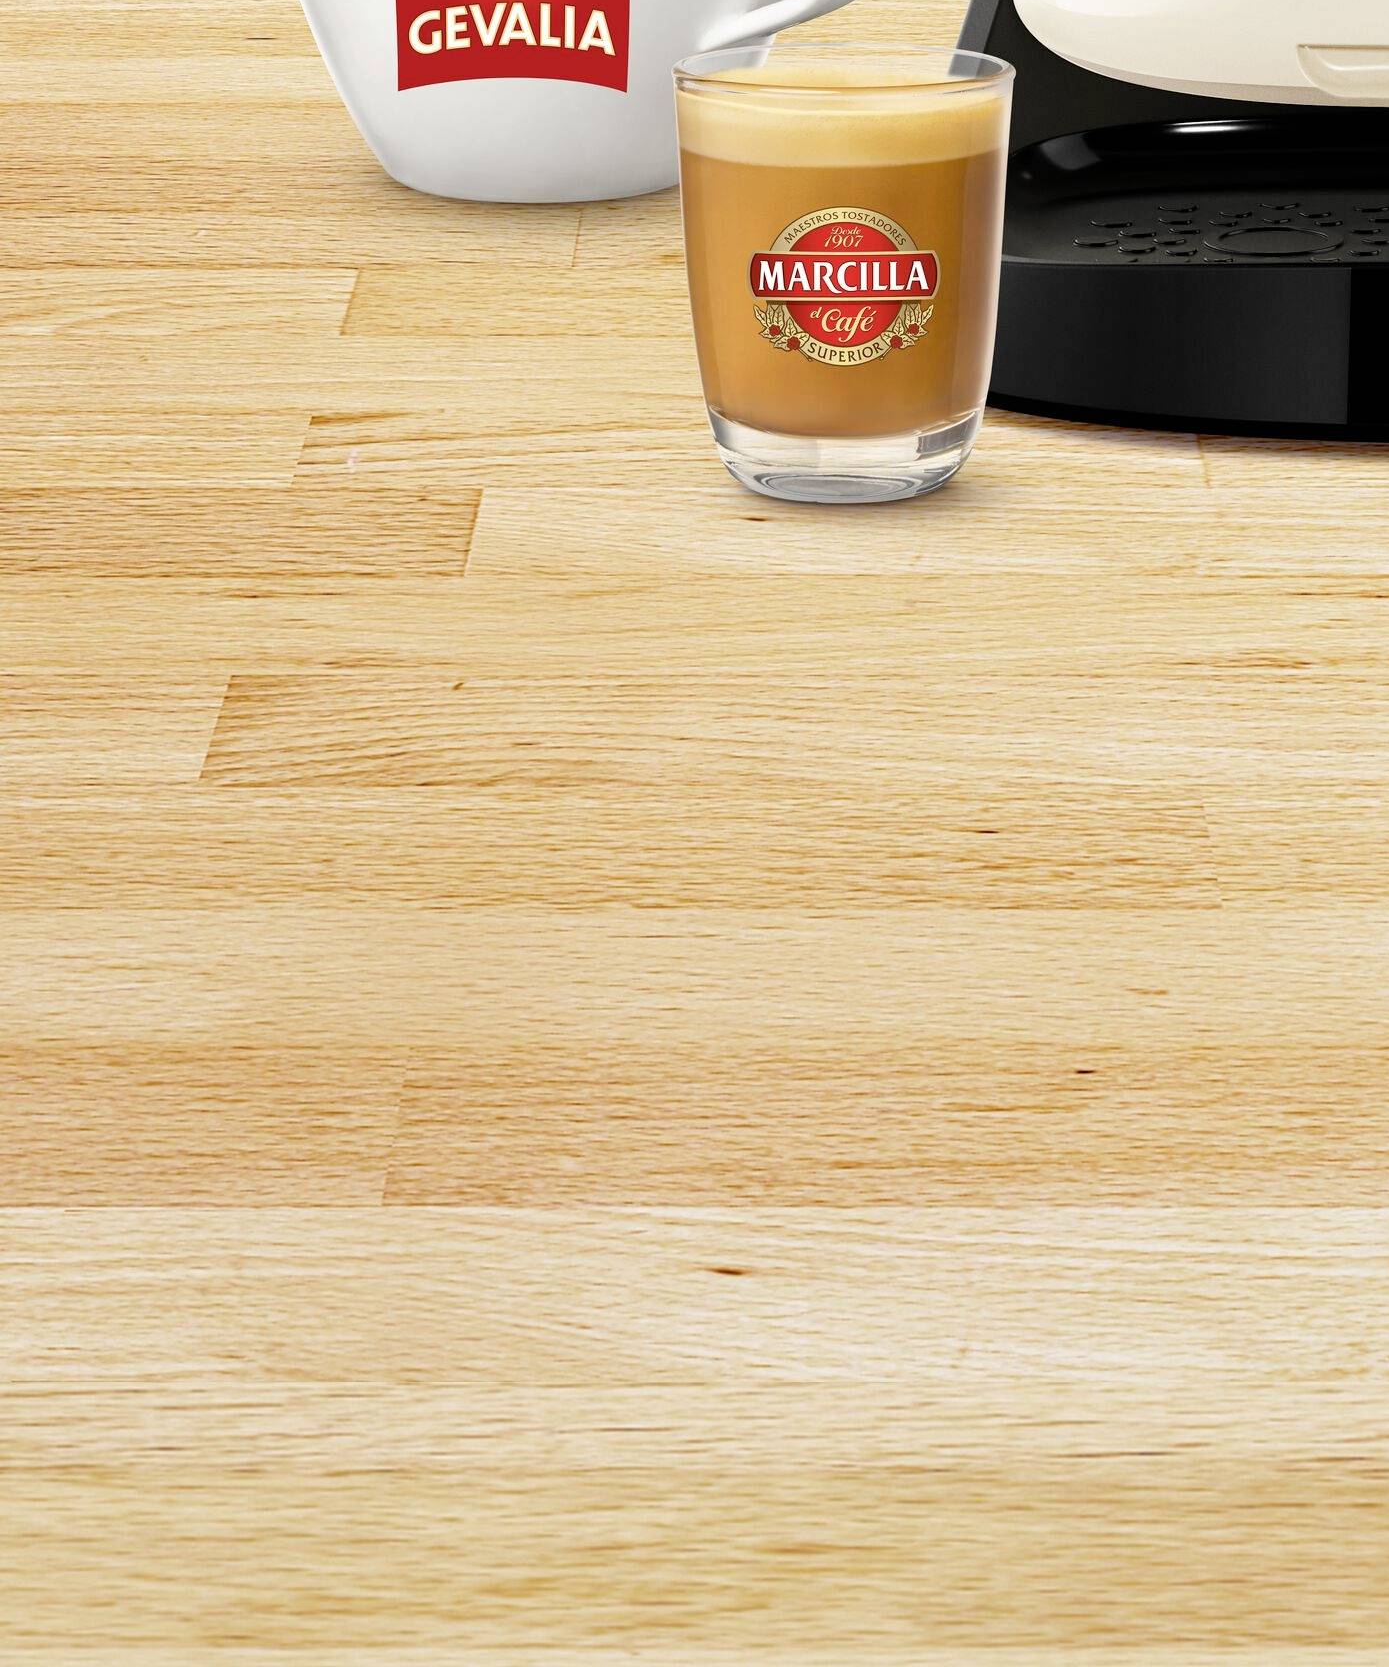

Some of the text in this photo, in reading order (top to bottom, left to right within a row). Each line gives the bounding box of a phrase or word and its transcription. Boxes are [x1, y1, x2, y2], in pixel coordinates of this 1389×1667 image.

[408, 2, 616, 56] GEVALIA
[784, 211, 907, 246] MAESTROS TOSTADORES
[824, 235, 863, 249] 1907
[831, 226, 861, 235] Desde
[758, 260, 929, 294] MARCILLA
[821, 306, 876, 342] Café
[807, 342, 883, 363] SUPERIOR
